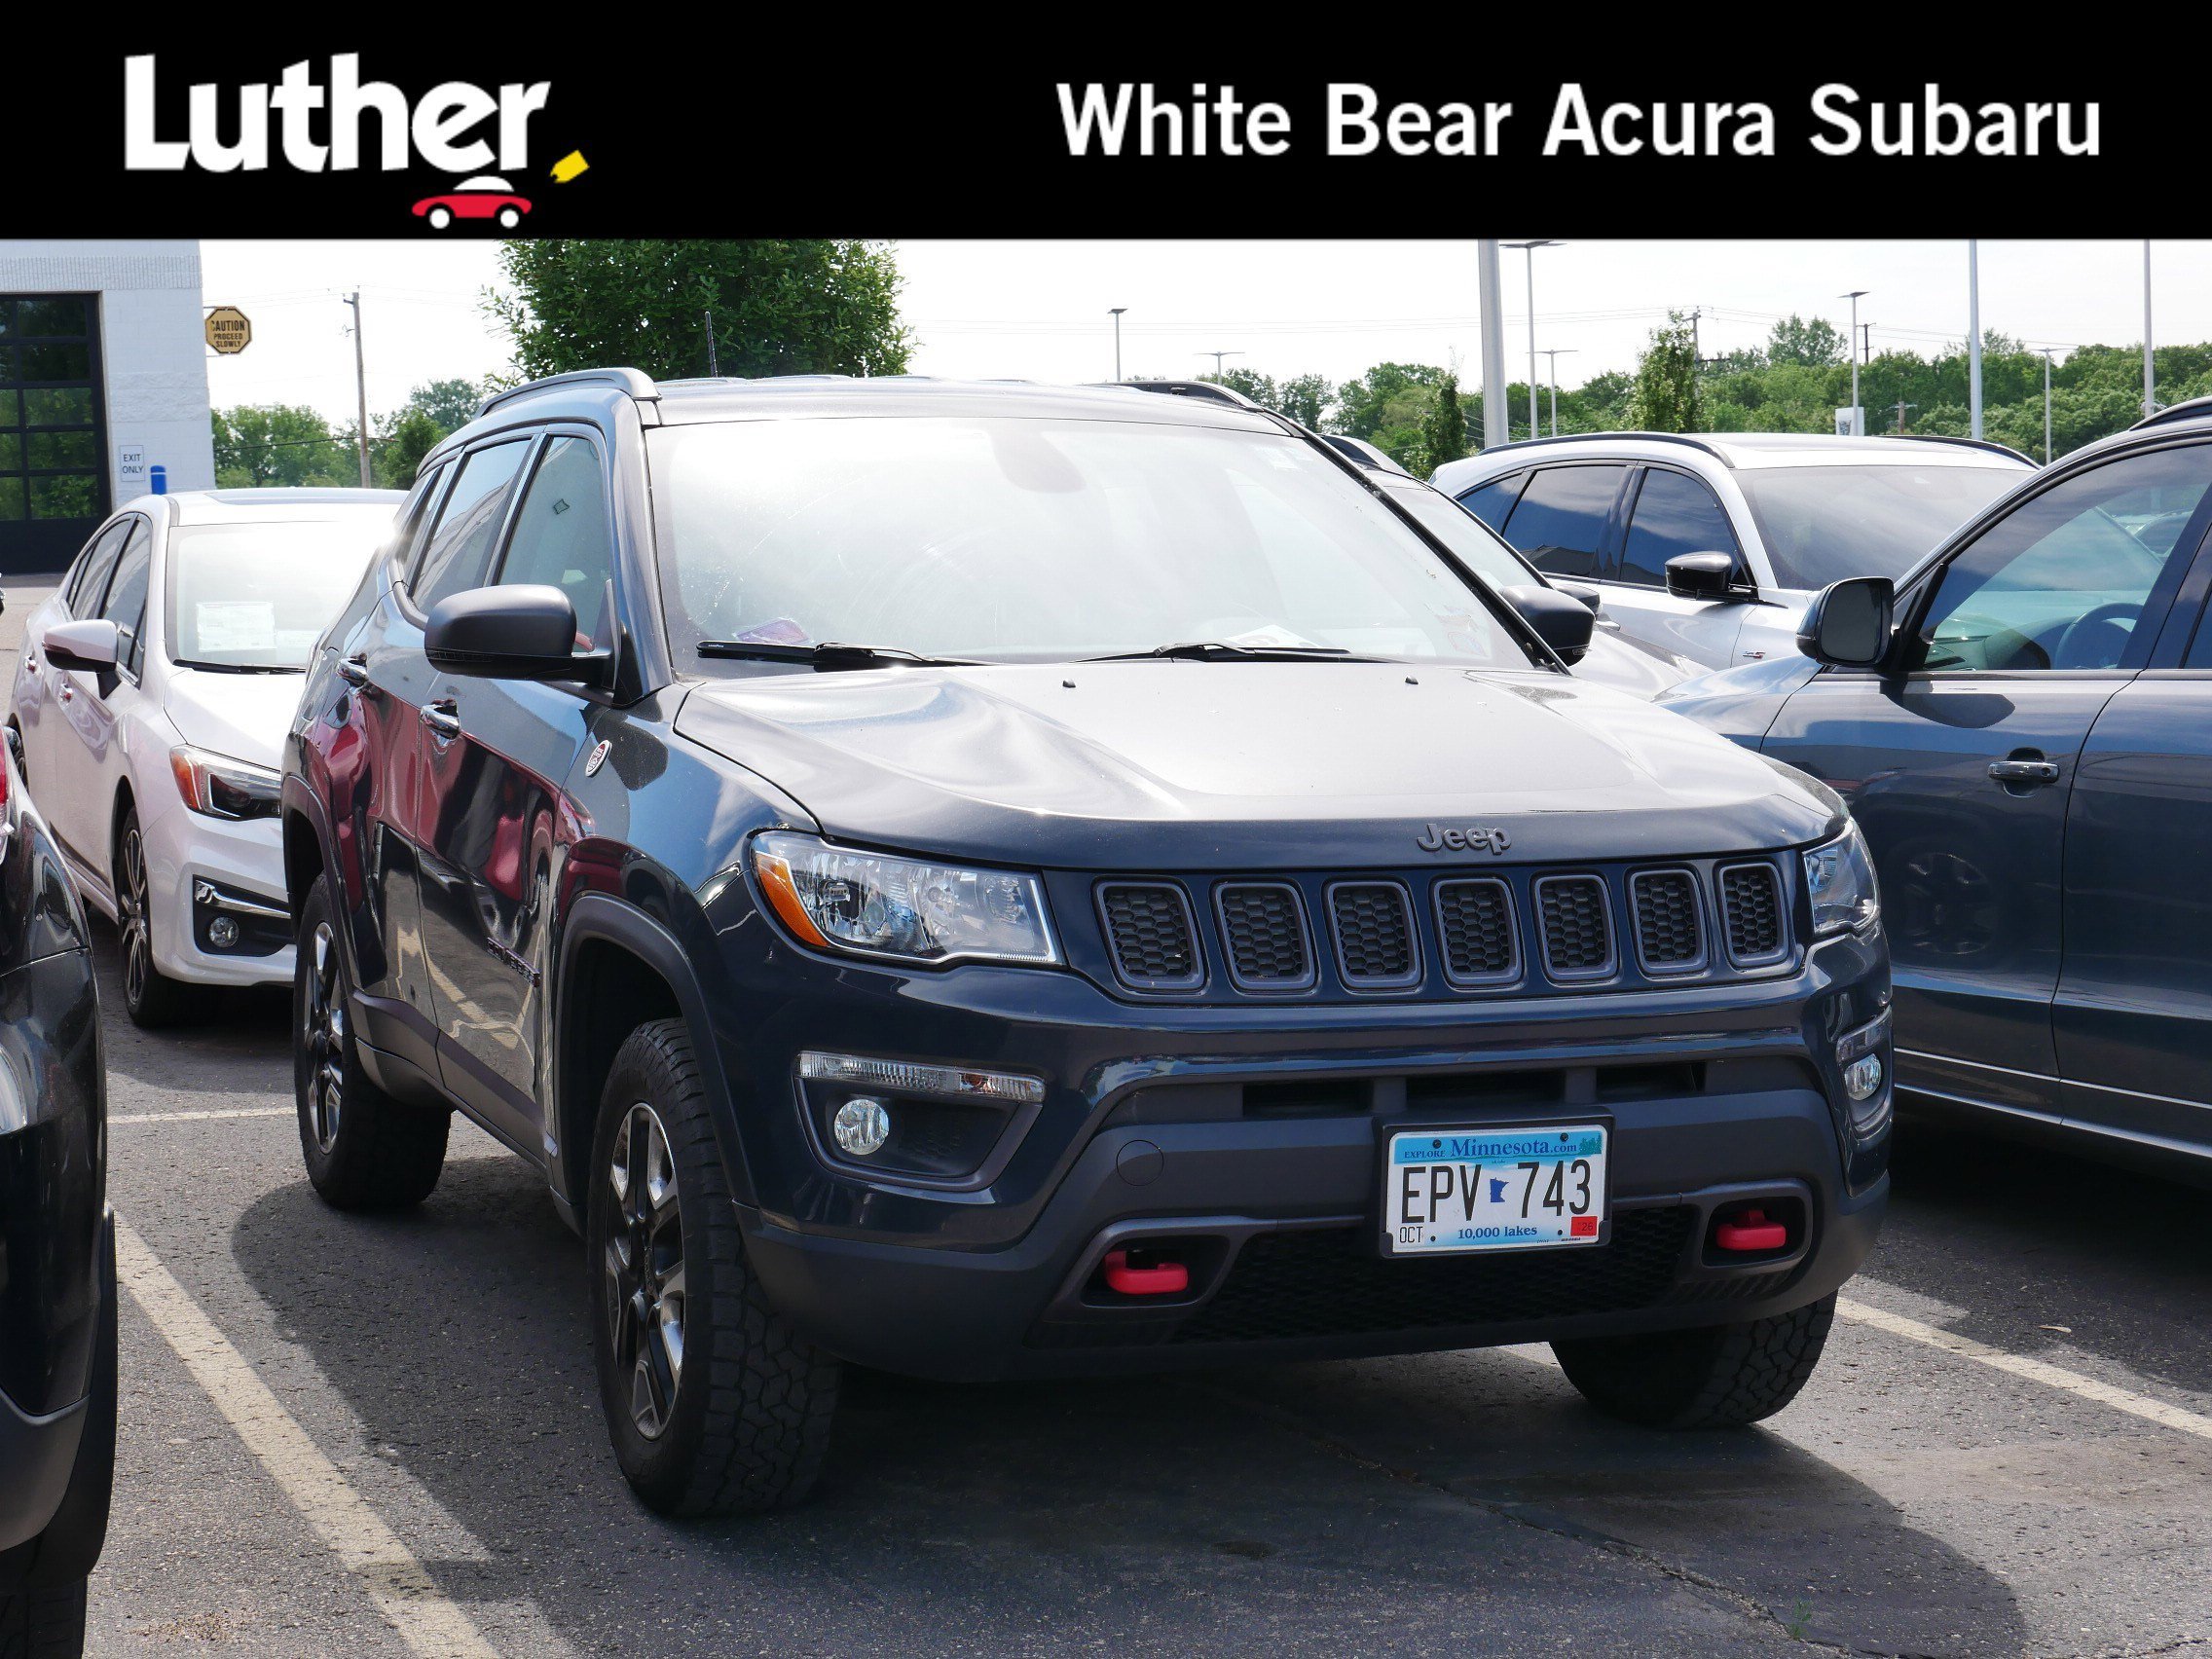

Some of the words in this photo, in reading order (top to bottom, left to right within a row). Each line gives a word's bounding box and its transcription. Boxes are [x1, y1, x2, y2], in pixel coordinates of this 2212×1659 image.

[210, 319, 245, 332] CAUTION
[1417, 823, 1512, 855] Jeep
[1404, 1150, 1447, 1159] EXPLORE
[1401, 1164, 1482, 1223] EPV
[1517, 1159, 1591, 1218] 743
[1399, 1226, 1423, 1243] OCT
[1457, 1228, 1500, 1240] 10,000
[1504, 1226, 1537, 1237] lakes
